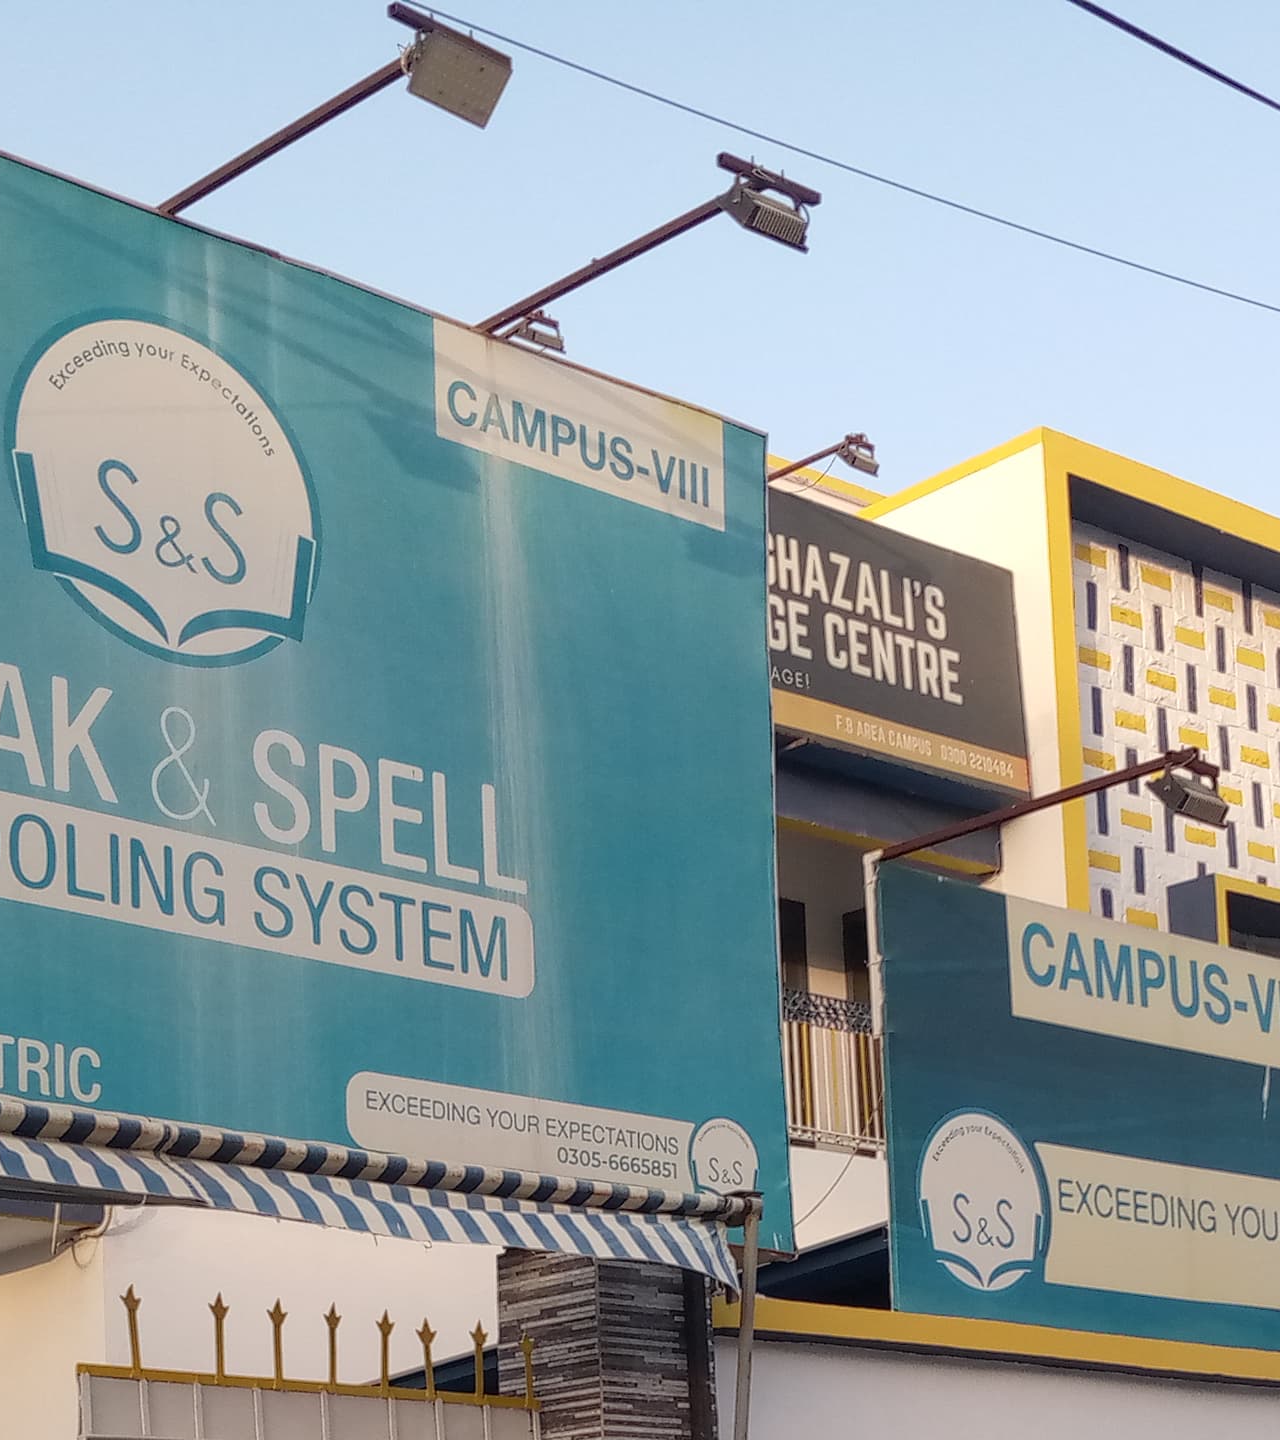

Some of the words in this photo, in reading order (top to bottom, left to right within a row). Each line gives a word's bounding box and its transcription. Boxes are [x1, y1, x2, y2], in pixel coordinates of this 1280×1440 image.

[48, 340, 130, 391] Exceeding
[134, 342, 176, 361] your
[180, 354, 276, 457] Expectations
[446, 380, 712, 509] CAMPUS-VIII
[94, 459, 247, 585] S&S
[823, 611, 964, 705] CENTRE
[857, 720, 886, 743] AREA
[888, 730, 933, 757] CAMPUS
[151, 706, 217, 828] &
[252, 729, 529, 895] SPELL
[253, 866, 510, 983] SYSTEM
[365, 1089, 481, 1126] EXCEEDING
[487, 1109, 540, 1135] YOUR
[546, 1119, 679, 1155] EXPECTATIONS
[557, 1146, 678, 1180] 0305-6665851
[708, 1156, 744, 1186] S&S
[952, 1193, 1015, 1249] S&S
[1057, 1178, 1217, 1233] EXCEEDING
